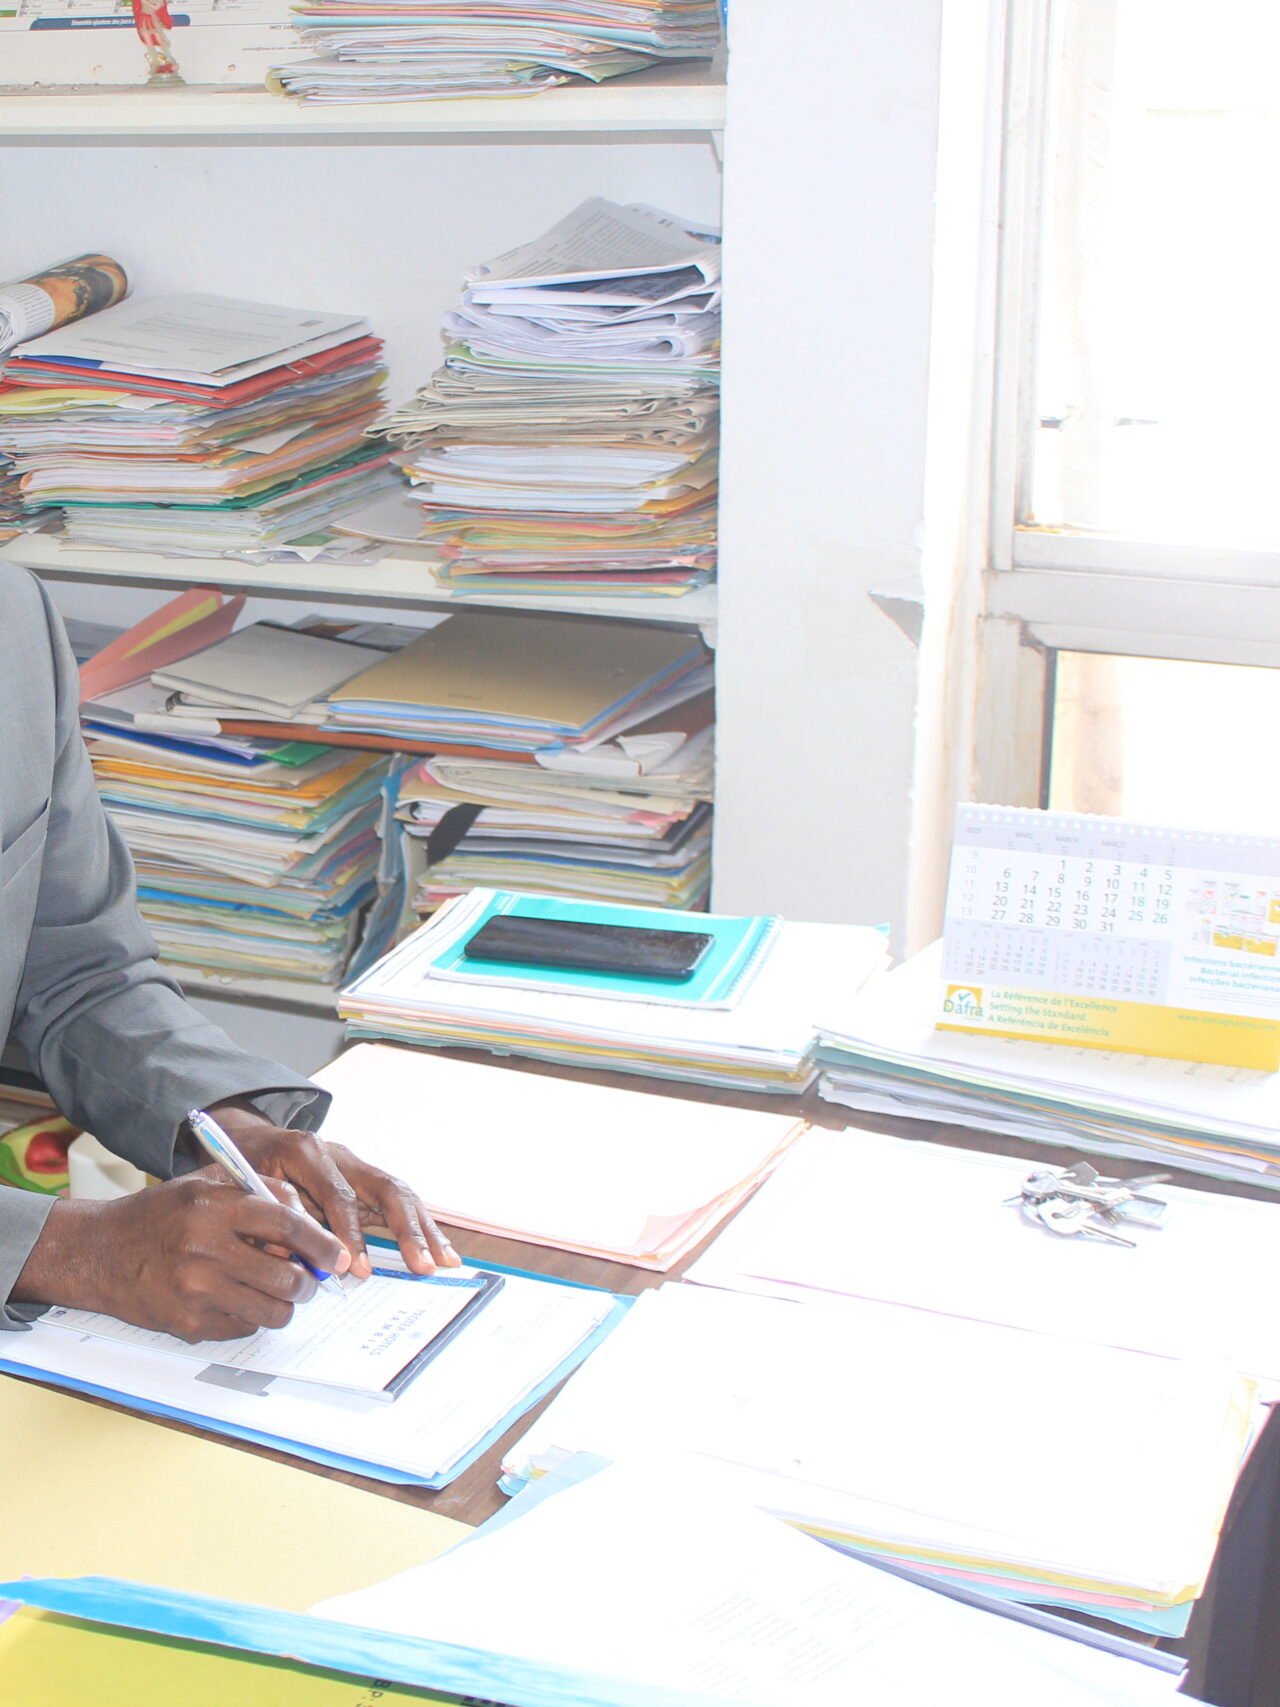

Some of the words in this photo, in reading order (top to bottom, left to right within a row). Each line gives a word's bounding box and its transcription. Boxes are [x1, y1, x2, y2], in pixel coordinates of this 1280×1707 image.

[1061, 859, 1066, 869] 1
[1085, 862, 1093, 873] 2
[1113, 865, 1123, 876] 3
[1139, 868, 1149, 878] 4
[1164, 869, 1173, 881] 5
[1003, 868, 1012, 879] 6
[1032, 870, 1040, 881] 7
[1057, 873, 1066, 884] 8
[1084, 876, 1092, 887] 9
[1106, 878, 1120, 890] 10
[1133, 880, 1146, 893] 11
[1158, 884, 1172, 896] 12
[995, 881, 1010, 893] 13
[1023, 884, 1038, 896] 14
[1048, 887, 1062, 898] 15
[1076, 890, 1090, 901] 16
[1104, 893, 1120, 904] 17
[1131, 896, 1146, 908] 18
[1156, 898, 1171, 910] 19
[991, 909, 1007, 920] 27
[1019, 912, 1034, 924] 28
[1045, 915, 1061, 927] 29
[1072, 918, 1087, 930] 30
[1100, 921, 1114, 932] 31
[992, 895, 1008, 907] 20
[1020, 898, 1034, 909] 21
[1046, 901, 1062, 913] 22
[1073, 904, 1089, 915] 23
[1101, 907, 1117, 918] 24
[1128, 909, 1145, 922] 25
[1152, 912, 1168, 925] 26
[1183, 955, 1227, 966] Infections
[1200, 967, 1240, 978] Bacterial
[943, 999, 984, 1017] Dafra
[991, 989, 1001, 999] La
[1003, 991, 1049, 1005] Référence
[1050, 996, 1062, 1006] de
[990, 1001, 1024, 1016] Setting
[1025, 1005, 1040, 1015] the
[1042, 1007, 1087, 1022] Standard
[988, 1014, 996, 1023] A
[997, 1014, 1046, 1029] Referência
[1047, 1020, 1059, 1030] de
[1061, 1021, 1111, 1037] Excelência
[392, 1308, 427, 1331] PROTEA
[369, 1332, 401, 1356] HOTELS
